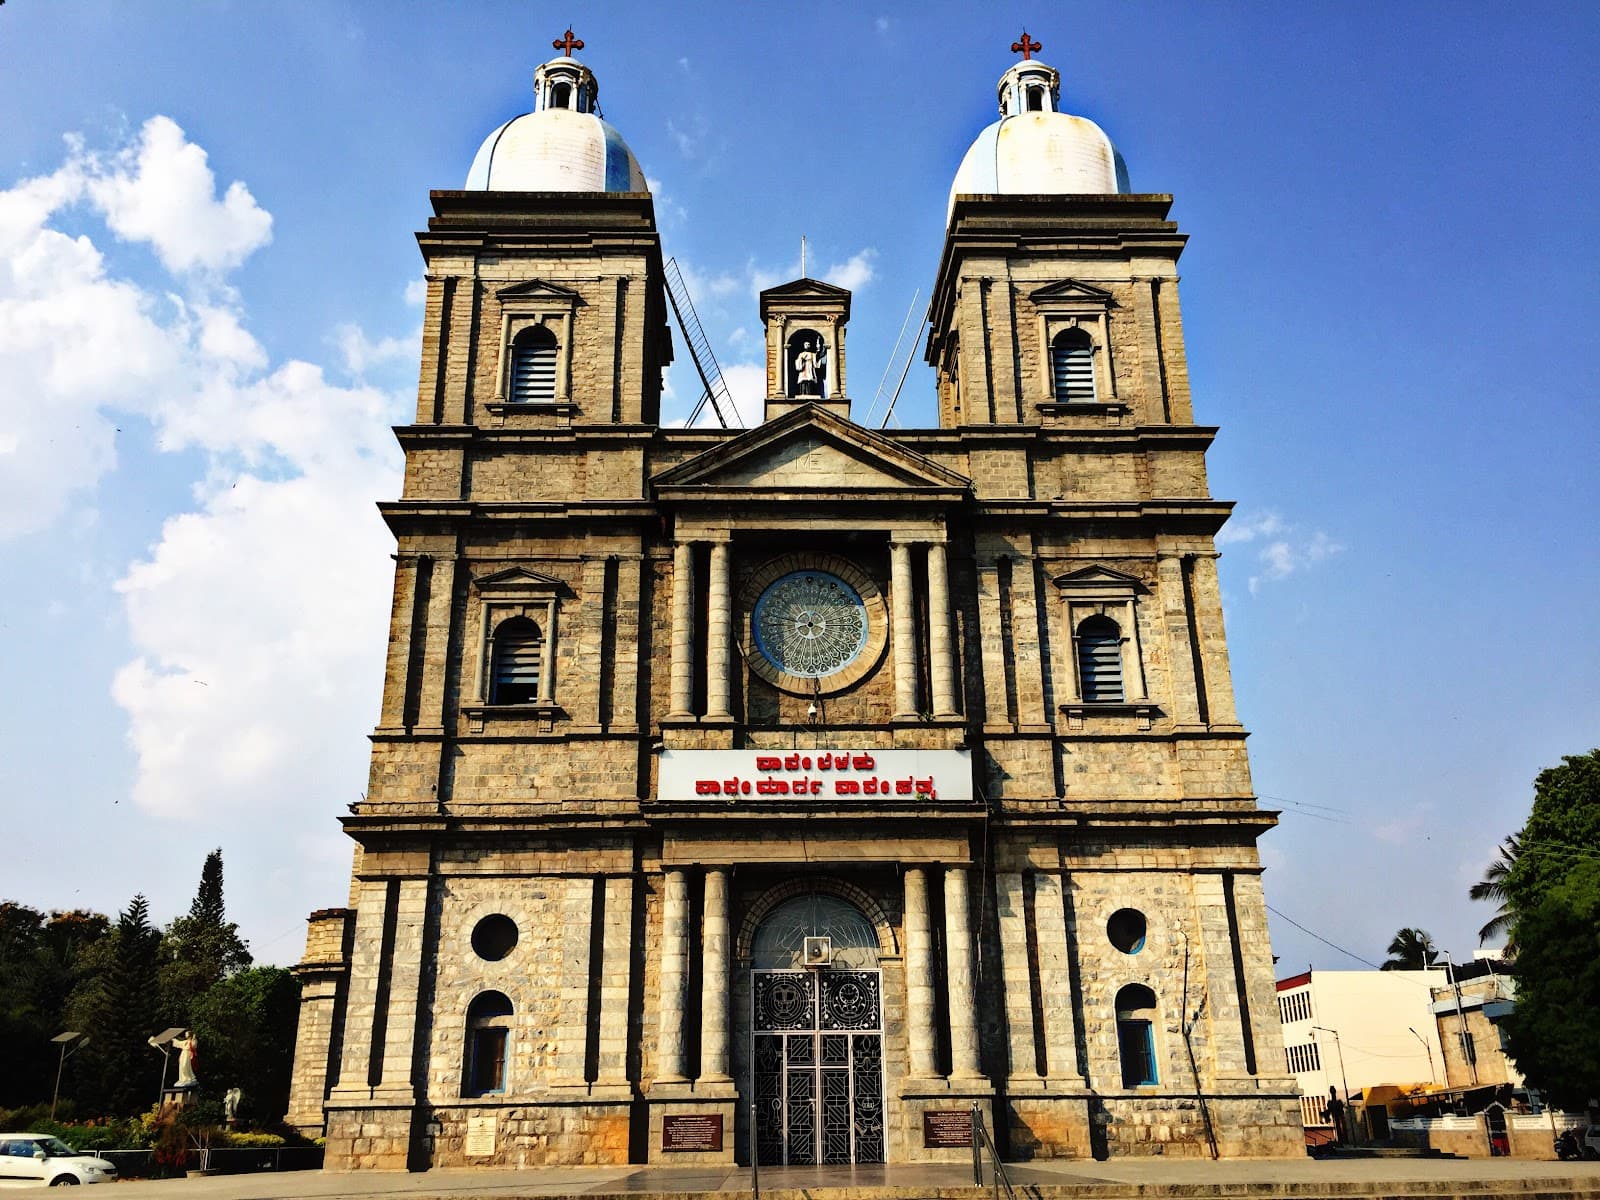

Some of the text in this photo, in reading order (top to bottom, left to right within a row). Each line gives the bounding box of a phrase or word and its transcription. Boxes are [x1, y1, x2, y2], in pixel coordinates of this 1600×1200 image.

[756, 752, 875, 770] ನಾನೇ ಬೆಳಕು
[694, 776, 938, 799] ನಾನೇ ಮಾರ್ಗ ನಾನೇ ಸತ್ಯ
